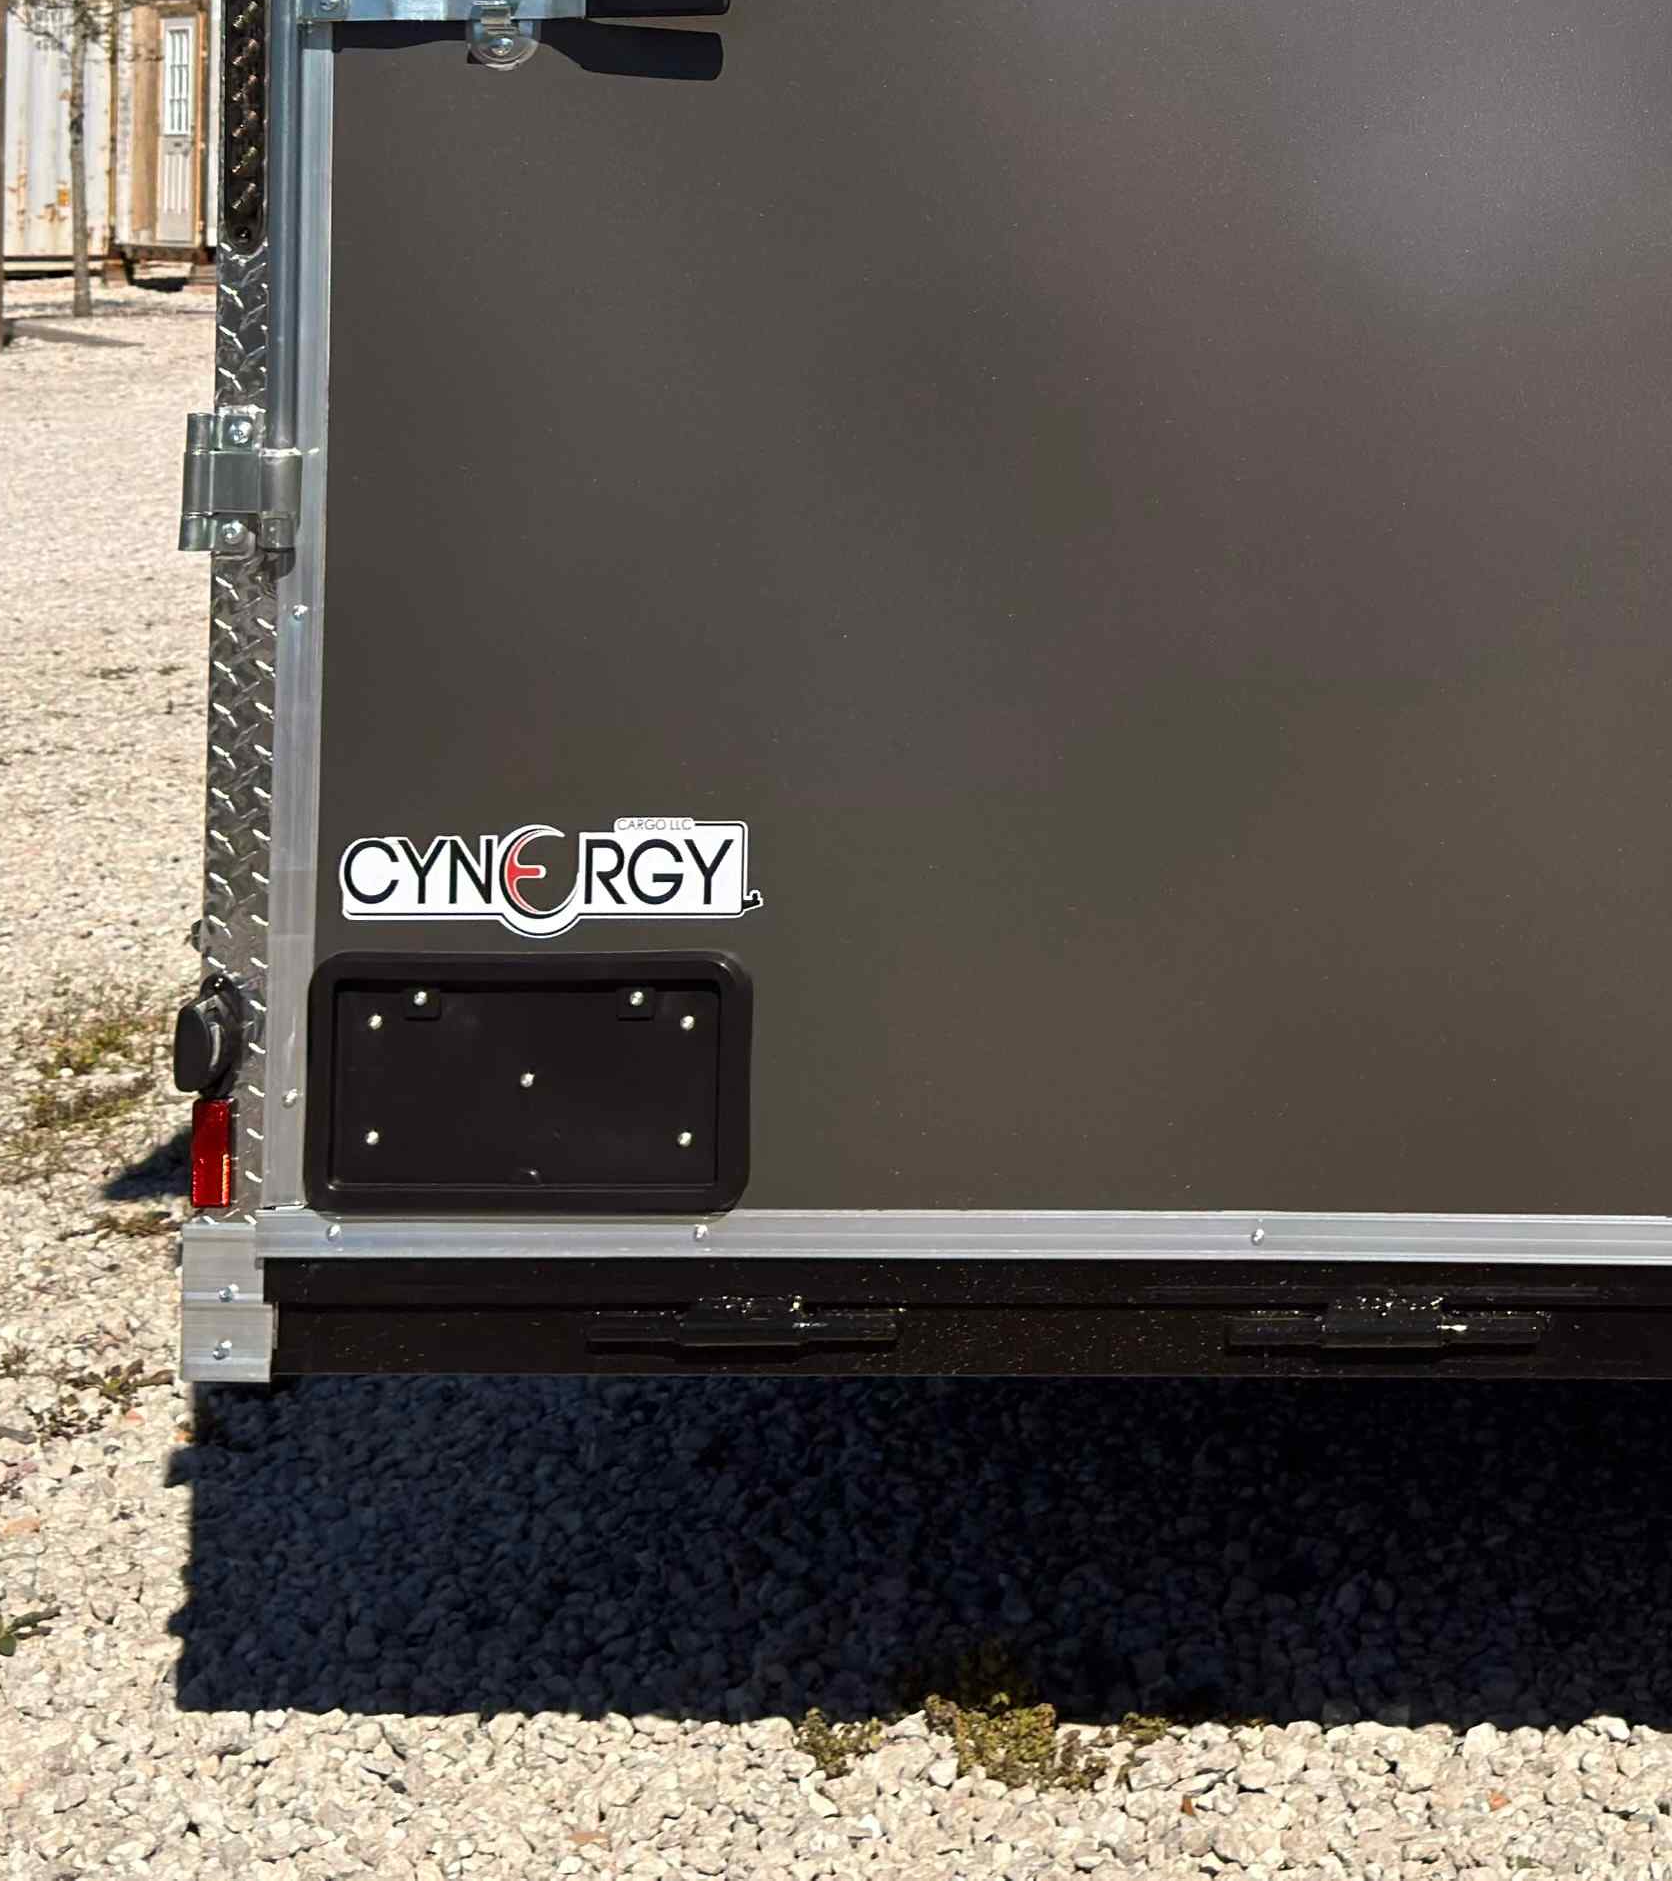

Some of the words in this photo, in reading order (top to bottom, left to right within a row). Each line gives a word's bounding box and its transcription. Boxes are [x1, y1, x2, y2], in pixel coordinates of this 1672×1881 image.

[617, 818, 666, 831] CARGO
[670, 818, 693, 831] LLC
[343, 827, 734, 919] CYNERGY
